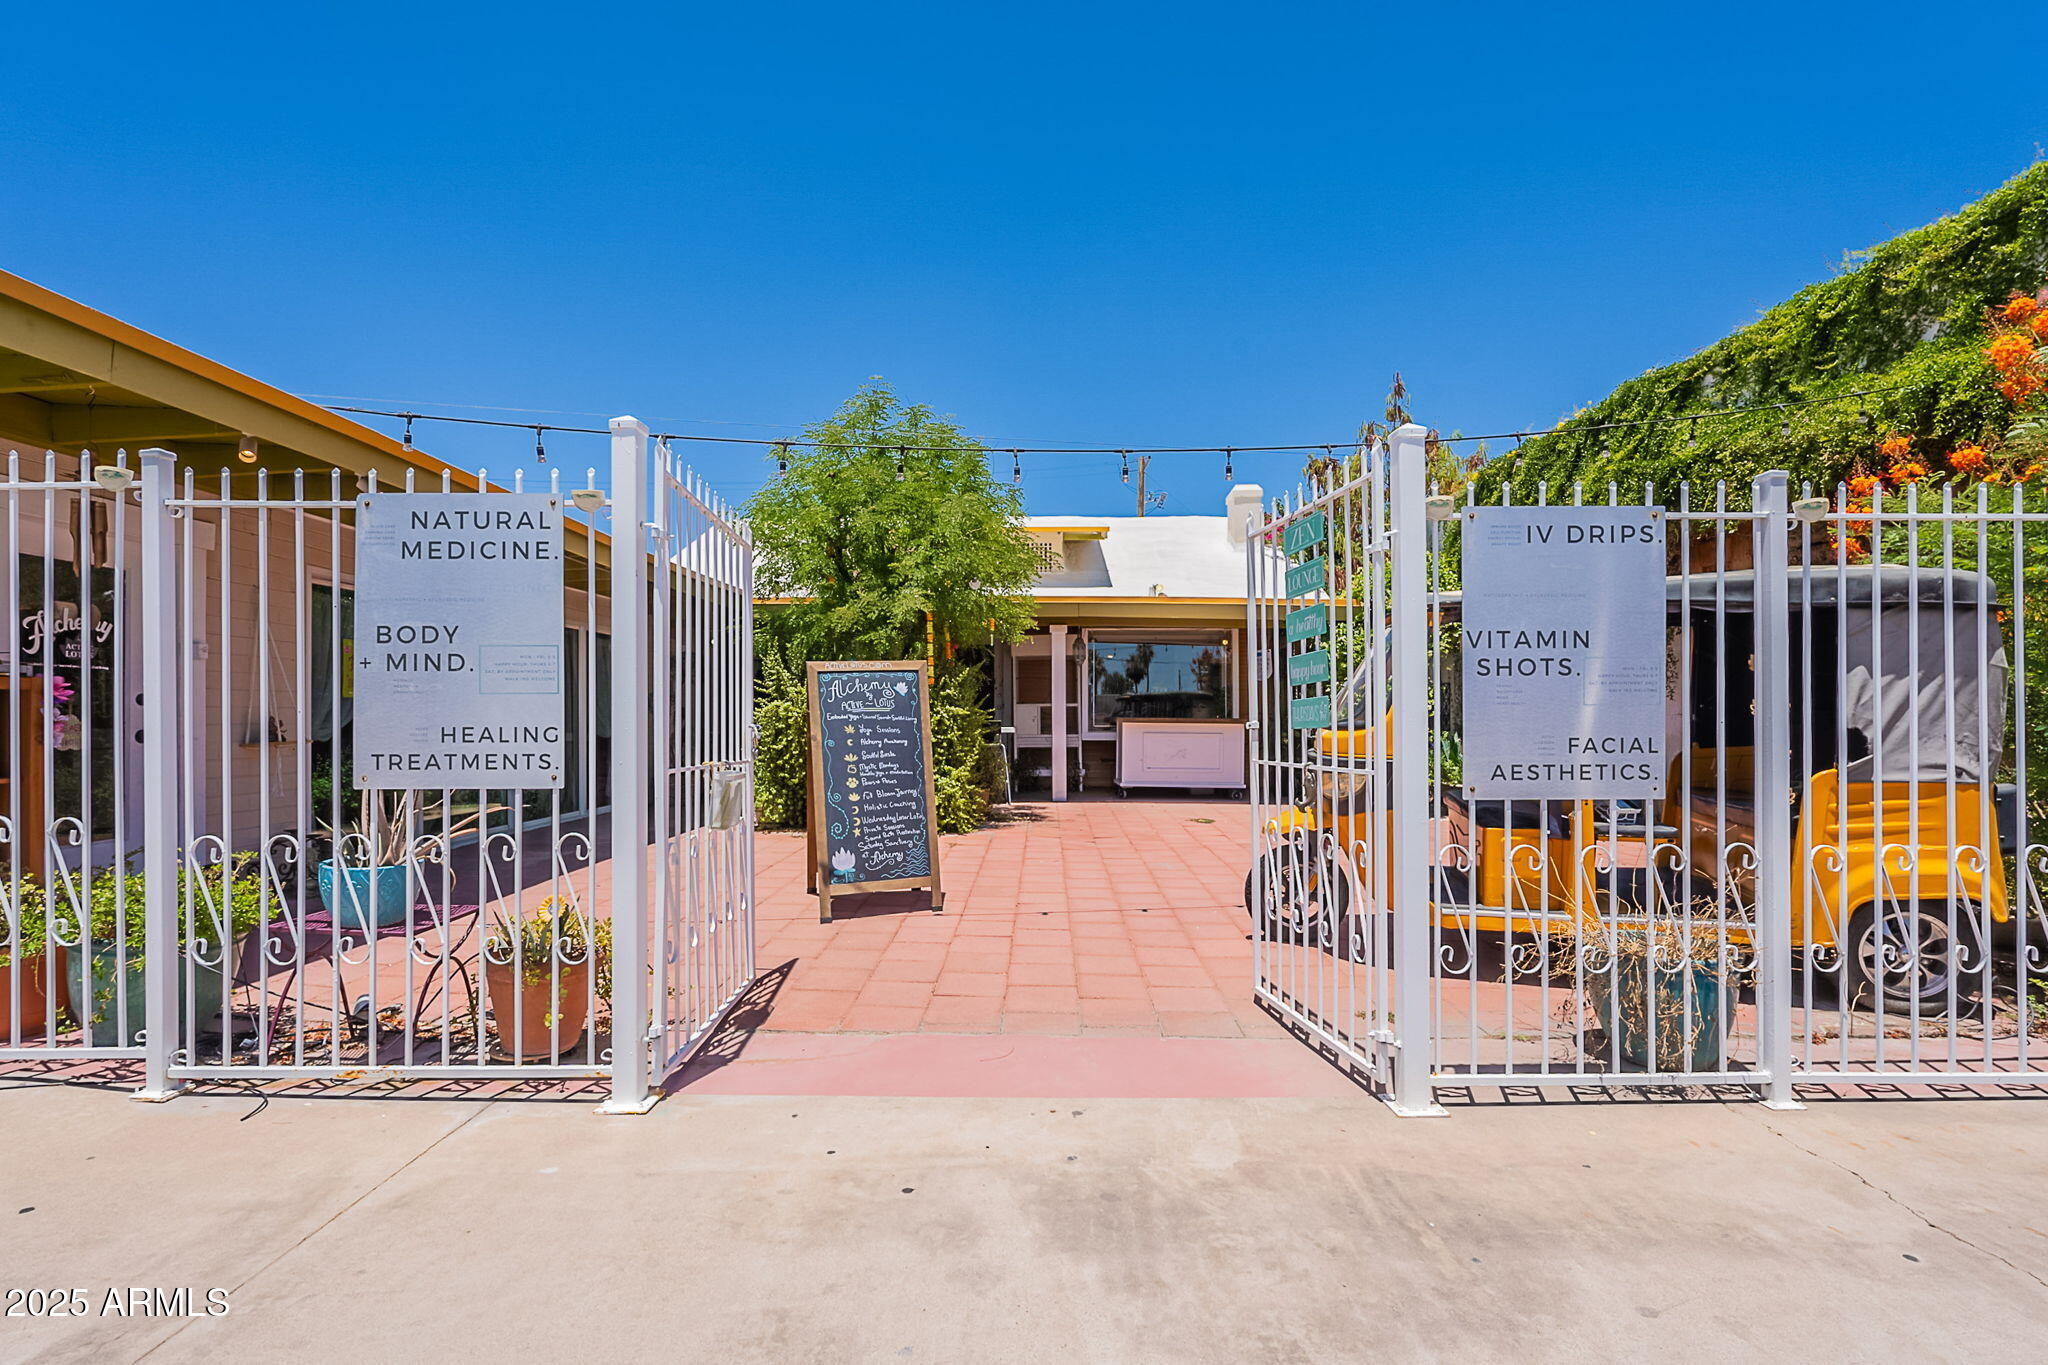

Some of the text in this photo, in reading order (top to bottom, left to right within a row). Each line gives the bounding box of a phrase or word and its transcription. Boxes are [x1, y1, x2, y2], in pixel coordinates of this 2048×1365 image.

[411, 511, 551, 530] NATURAL
[1291, 520, 1316, 549] ZEN
[1526, 525, 1554, 544] IV
[1567, 525, 1663, 544] DRIPS.
[401, 541, 560, 560] MEDICINE.
[1288, 565, 1321, 592] LOUNGE
[1296, 614, 1323, 632] healthy
[376, 625, 460, 644] BODY
[1466, 630, 1590, 649] VITAMIN
[359, 653, 475, 672] + MIND.
[1291, 663, 1310, 681] happy
[1310, 660, 1326, 676] hour
[1476, 658, 1582, 677] SHOTS.
[828, 678, 896, 703] Alchemy
[841, 698, 896, 711] ACTIVE LOTUS
[440, 726, 560, 744] HEALING
[858, 724, 900, 736] Yoga Sessions
[1568, 737, 1659, 754] FACIAL
[371, 753, 560, 771] TREATMENTS.
[1490, 764, 1658, 781] AESTHETICS.
[870, 851, 904, 865] Alchemy
